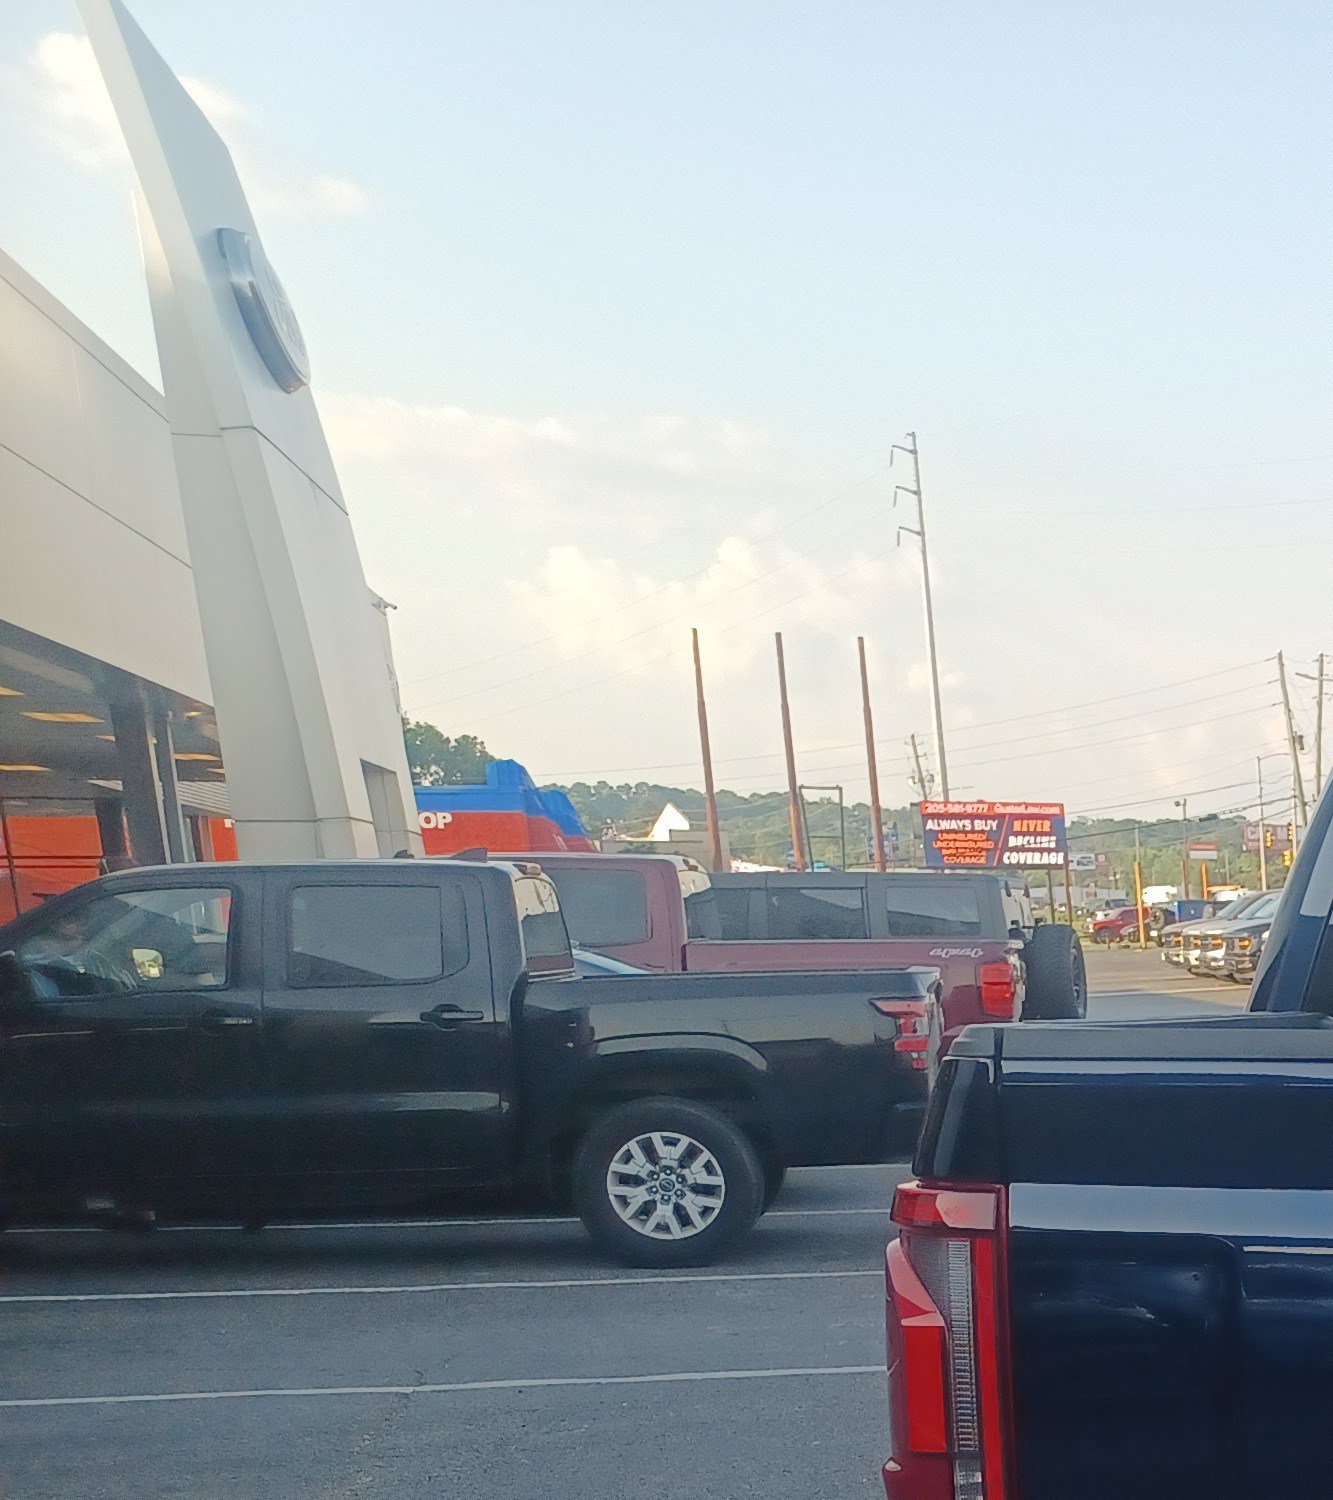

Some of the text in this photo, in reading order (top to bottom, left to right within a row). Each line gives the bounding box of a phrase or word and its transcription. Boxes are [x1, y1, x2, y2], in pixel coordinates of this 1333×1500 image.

[925, 819, 999, 831] ALWAYS BUY
[1013, 820, 1051, 832] NEVER
[1003, 852, 1065, 865] COVERAGE
